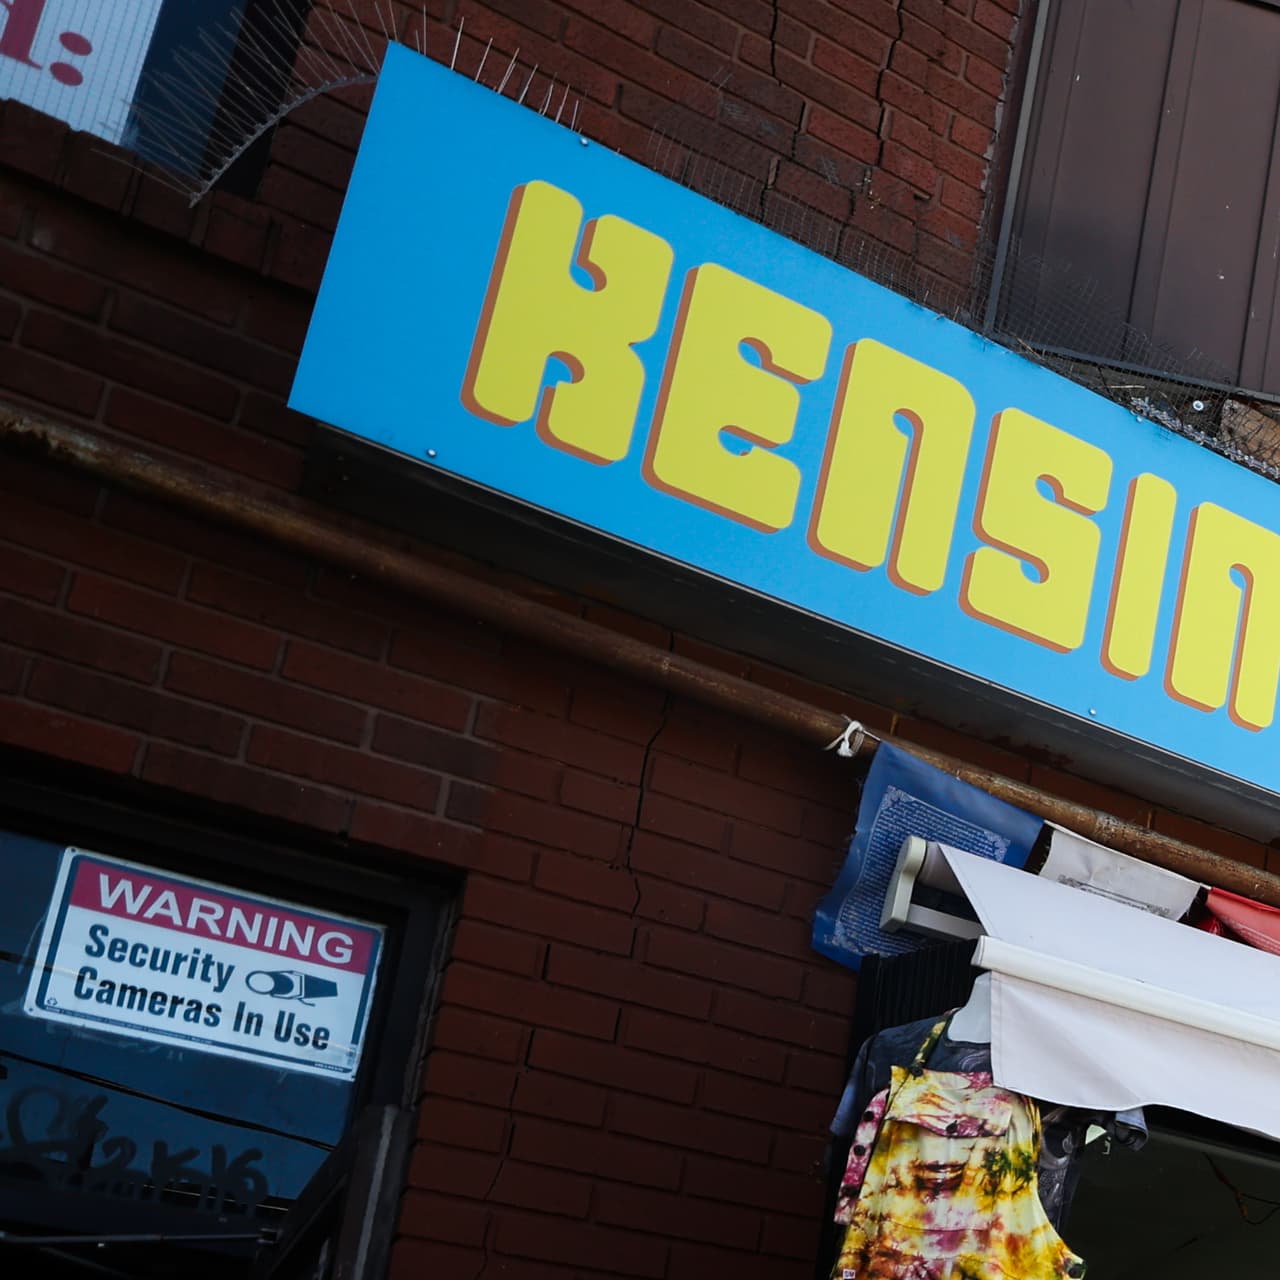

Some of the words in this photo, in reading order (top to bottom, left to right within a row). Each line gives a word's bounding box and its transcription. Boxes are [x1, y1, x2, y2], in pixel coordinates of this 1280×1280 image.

[84, 923, 235, 992] Security
[98, 872, 354, 964] WARNING
[74, 965, 222, 1028] Cameras
[233, 1001, 264, 1037] In
[274, 1010, 331, 1051] Use
